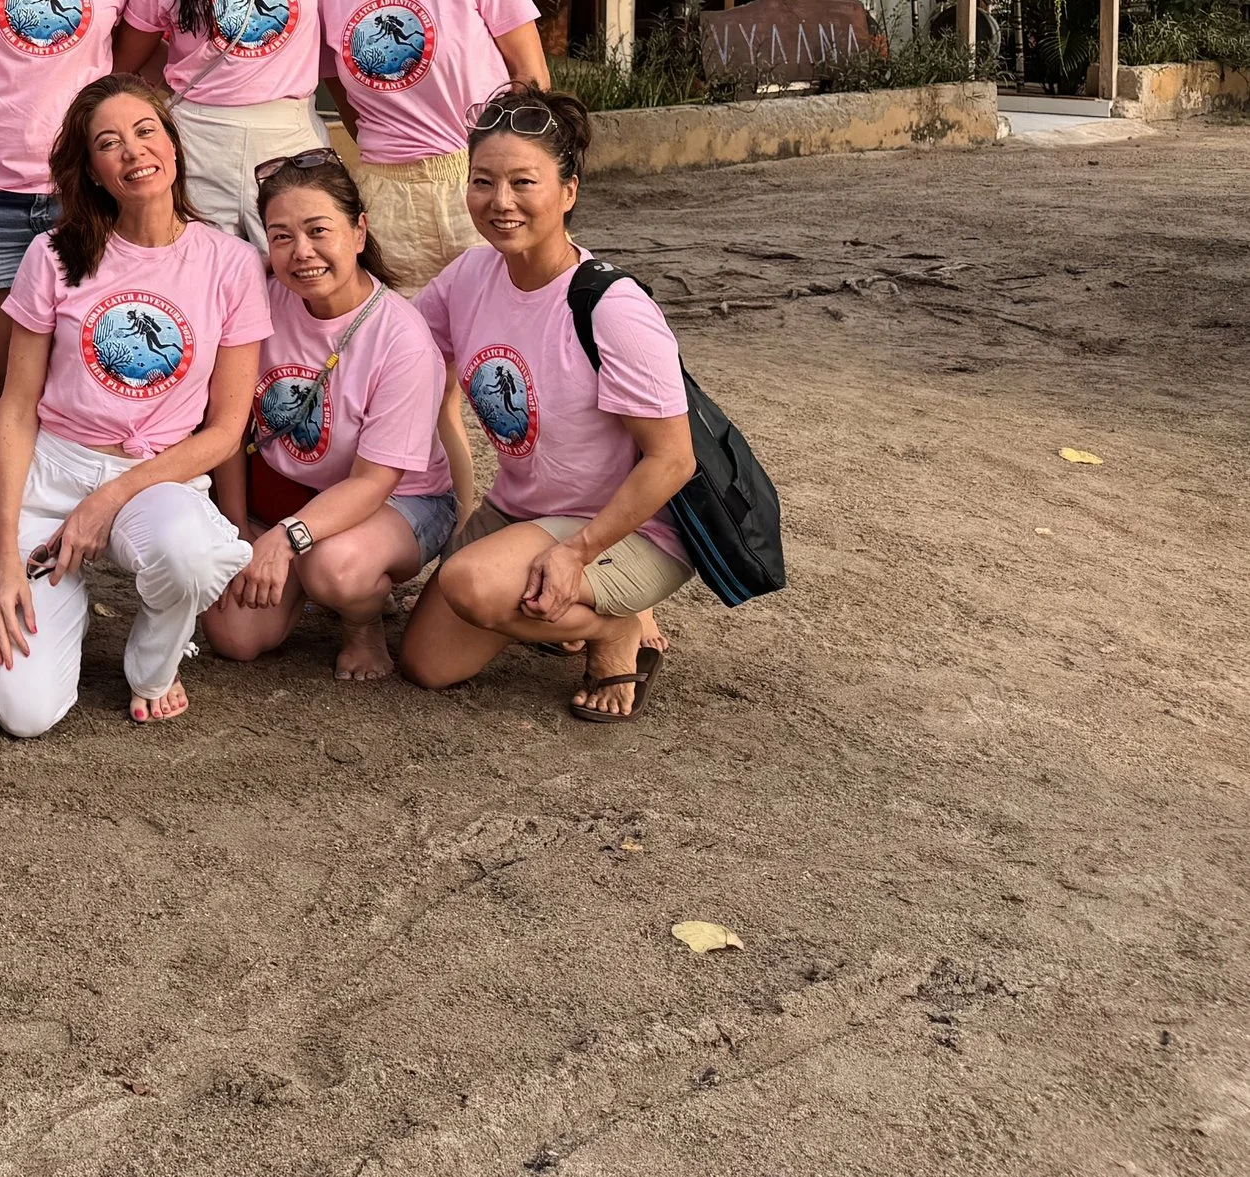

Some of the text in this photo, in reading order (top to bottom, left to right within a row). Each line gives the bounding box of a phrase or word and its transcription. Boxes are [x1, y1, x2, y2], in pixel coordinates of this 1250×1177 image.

[344, 22, 356, 46] CORAL
[355, 2, 378, 22] CATCH
[2, 28, 79, 54] HER PLANET EARTH
[232, 47, 262, 56] LANET
[264, 32, 288, 52] EARTH
[355, 58, 428, 89] HER PLANET EARTH
[86, 294, 193, 345] CORAL CATCH ADVENTURE 2025
[90, 363, 177, 397] HER PLANET EARTH
[273, 368, 298, 378] CATCH
[464, 348, 536, 412] CORAL CATCH ADVENTURE 2025
